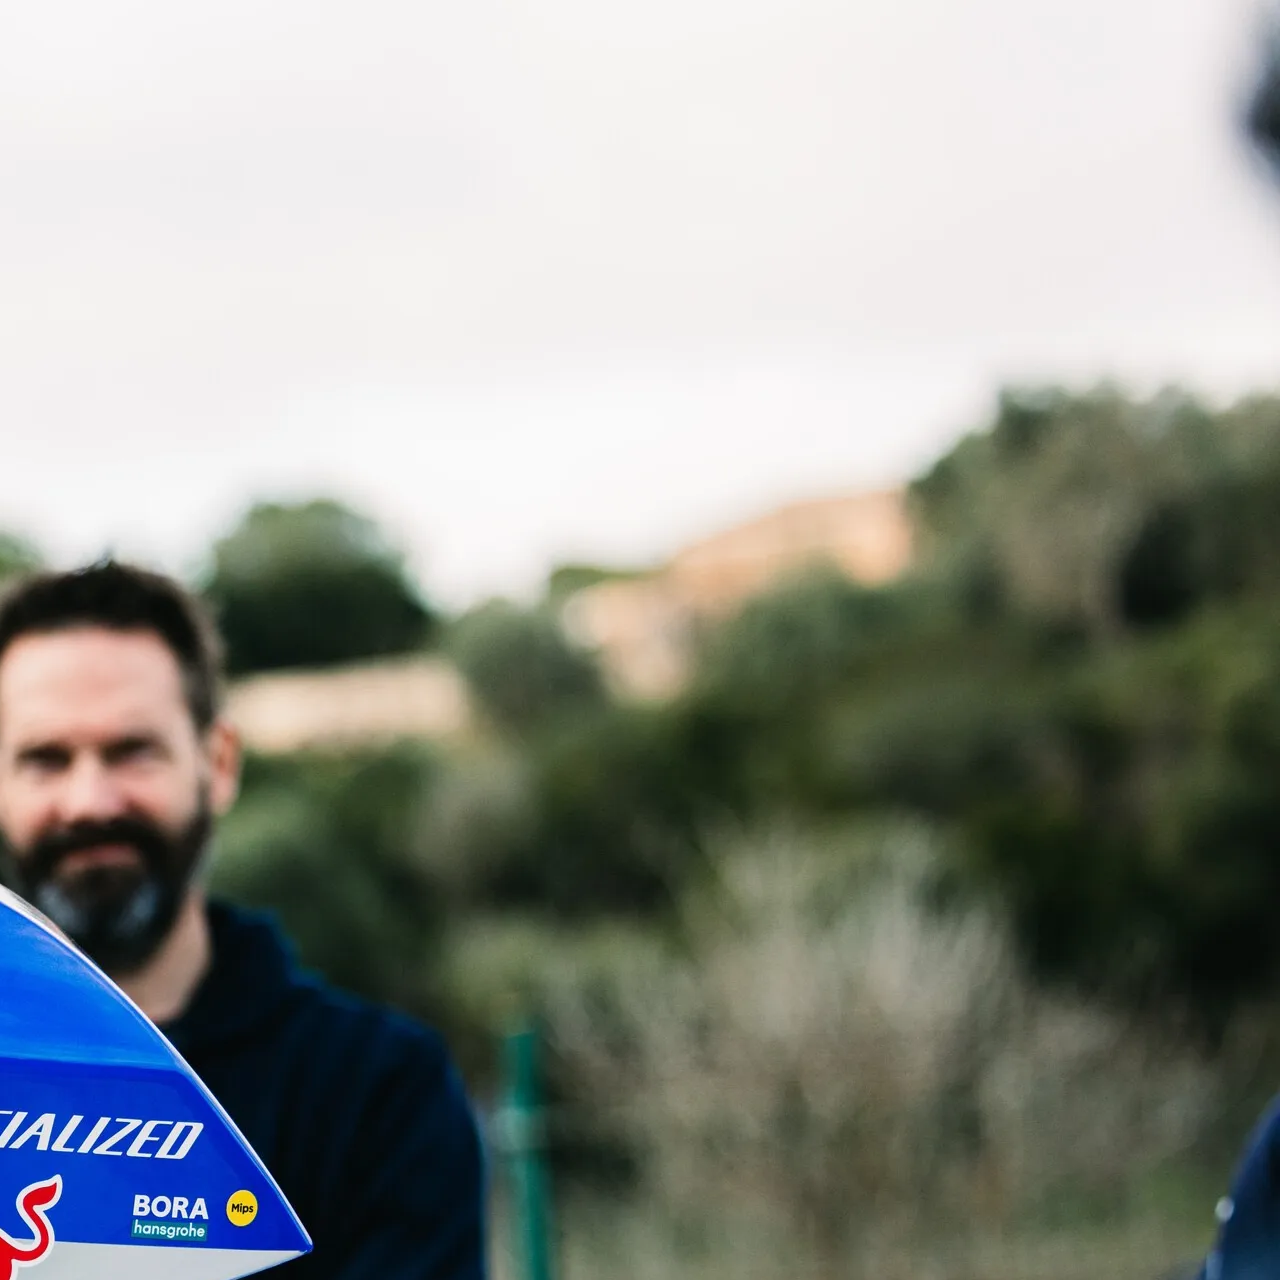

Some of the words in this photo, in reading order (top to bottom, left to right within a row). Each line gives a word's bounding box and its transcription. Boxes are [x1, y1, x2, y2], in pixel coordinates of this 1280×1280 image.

[132, 1194, 209, 1220] BORA
[231, 1203, 254, 1214] Mips
[134, 1219, 205, 1239] hansgrohe
